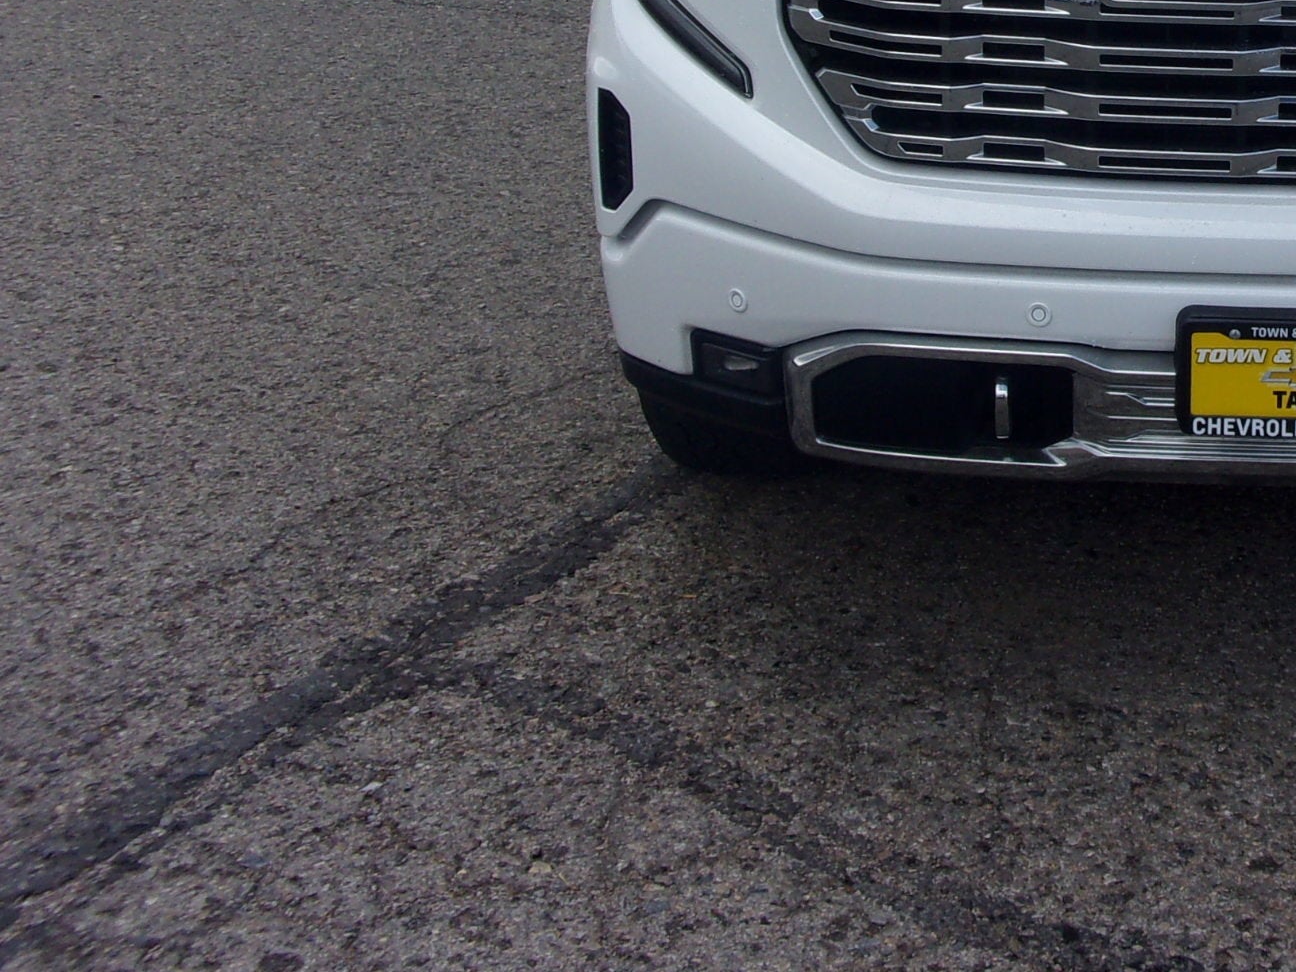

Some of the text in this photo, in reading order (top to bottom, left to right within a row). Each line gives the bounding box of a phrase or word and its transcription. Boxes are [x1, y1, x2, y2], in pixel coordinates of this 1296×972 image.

[1251, 327, 1290, 339] TOWN
[1195, 348, 1267, 364] TOWN
[1273, 349, 1292, 364] &
